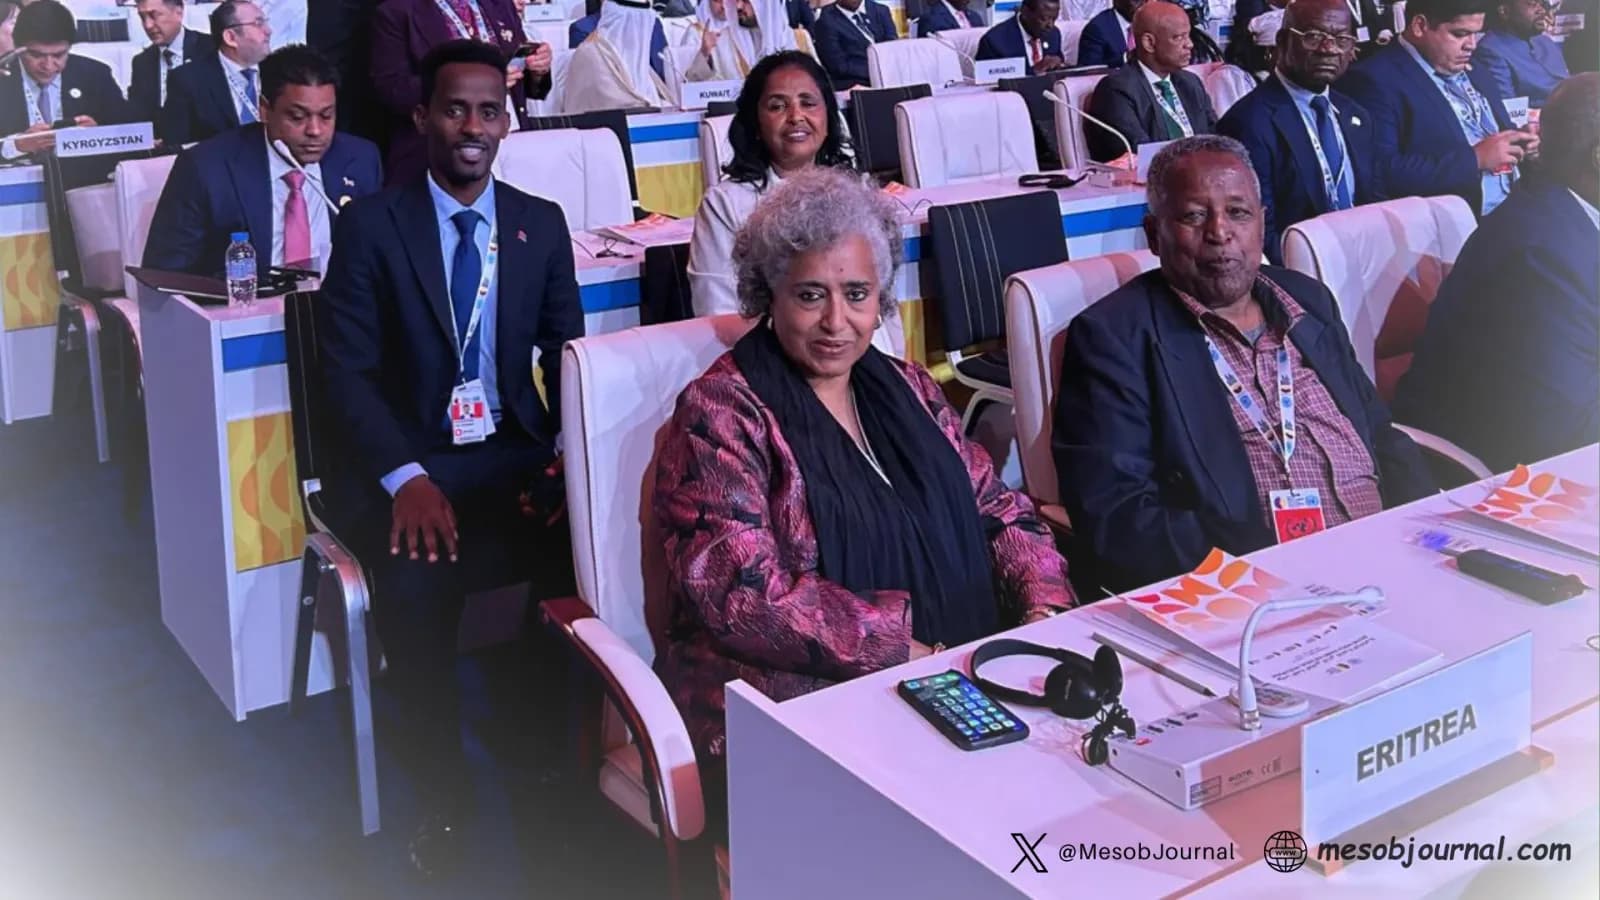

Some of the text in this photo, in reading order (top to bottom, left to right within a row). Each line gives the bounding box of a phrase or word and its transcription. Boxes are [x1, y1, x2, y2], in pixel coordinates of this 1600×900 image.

[700, 89, 730, 98] KUWAIT
[63, 135, 143, 150] KYRGYZSTAN
[1357, 703, 1477, 783] ERITREA
